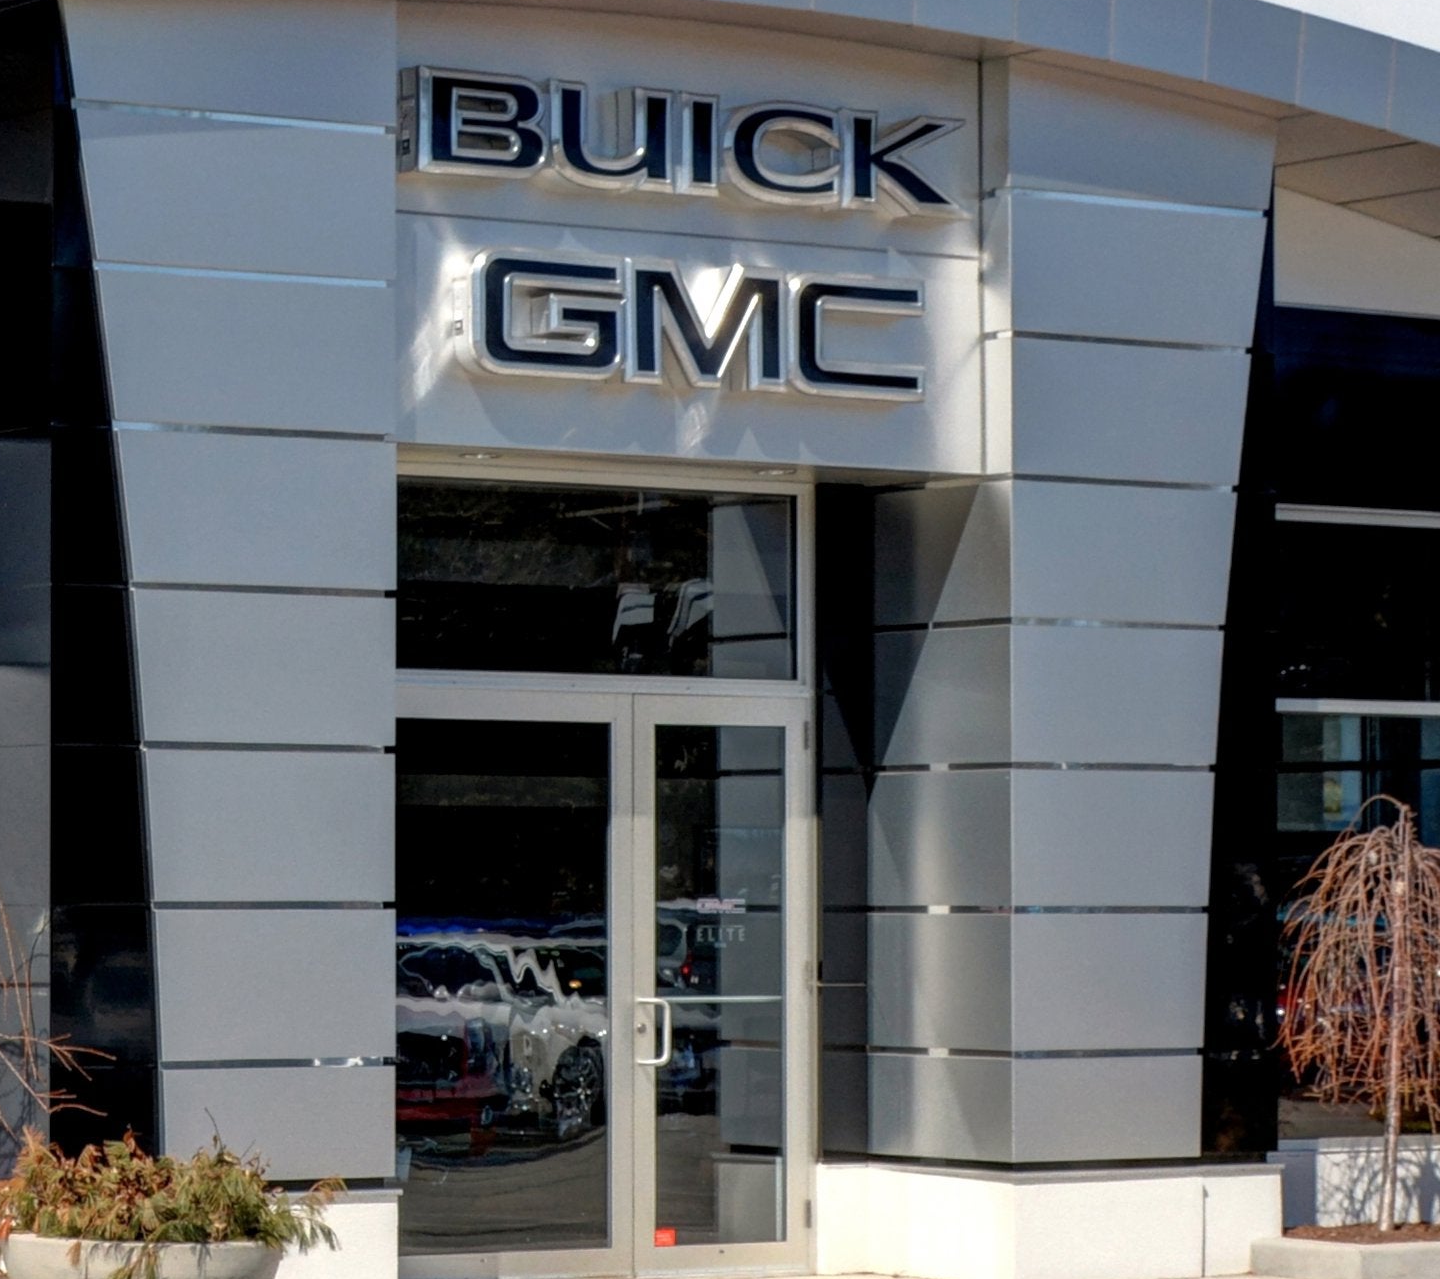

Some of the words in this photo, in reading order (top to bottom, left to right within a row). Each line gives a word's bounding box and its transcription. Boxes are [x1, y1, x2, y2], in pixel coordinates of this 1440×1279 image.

[418, 65, 970, 219] BUICK
[466, 247, 926, 402] GMC
[697, 927, 746, 942] ELITE
